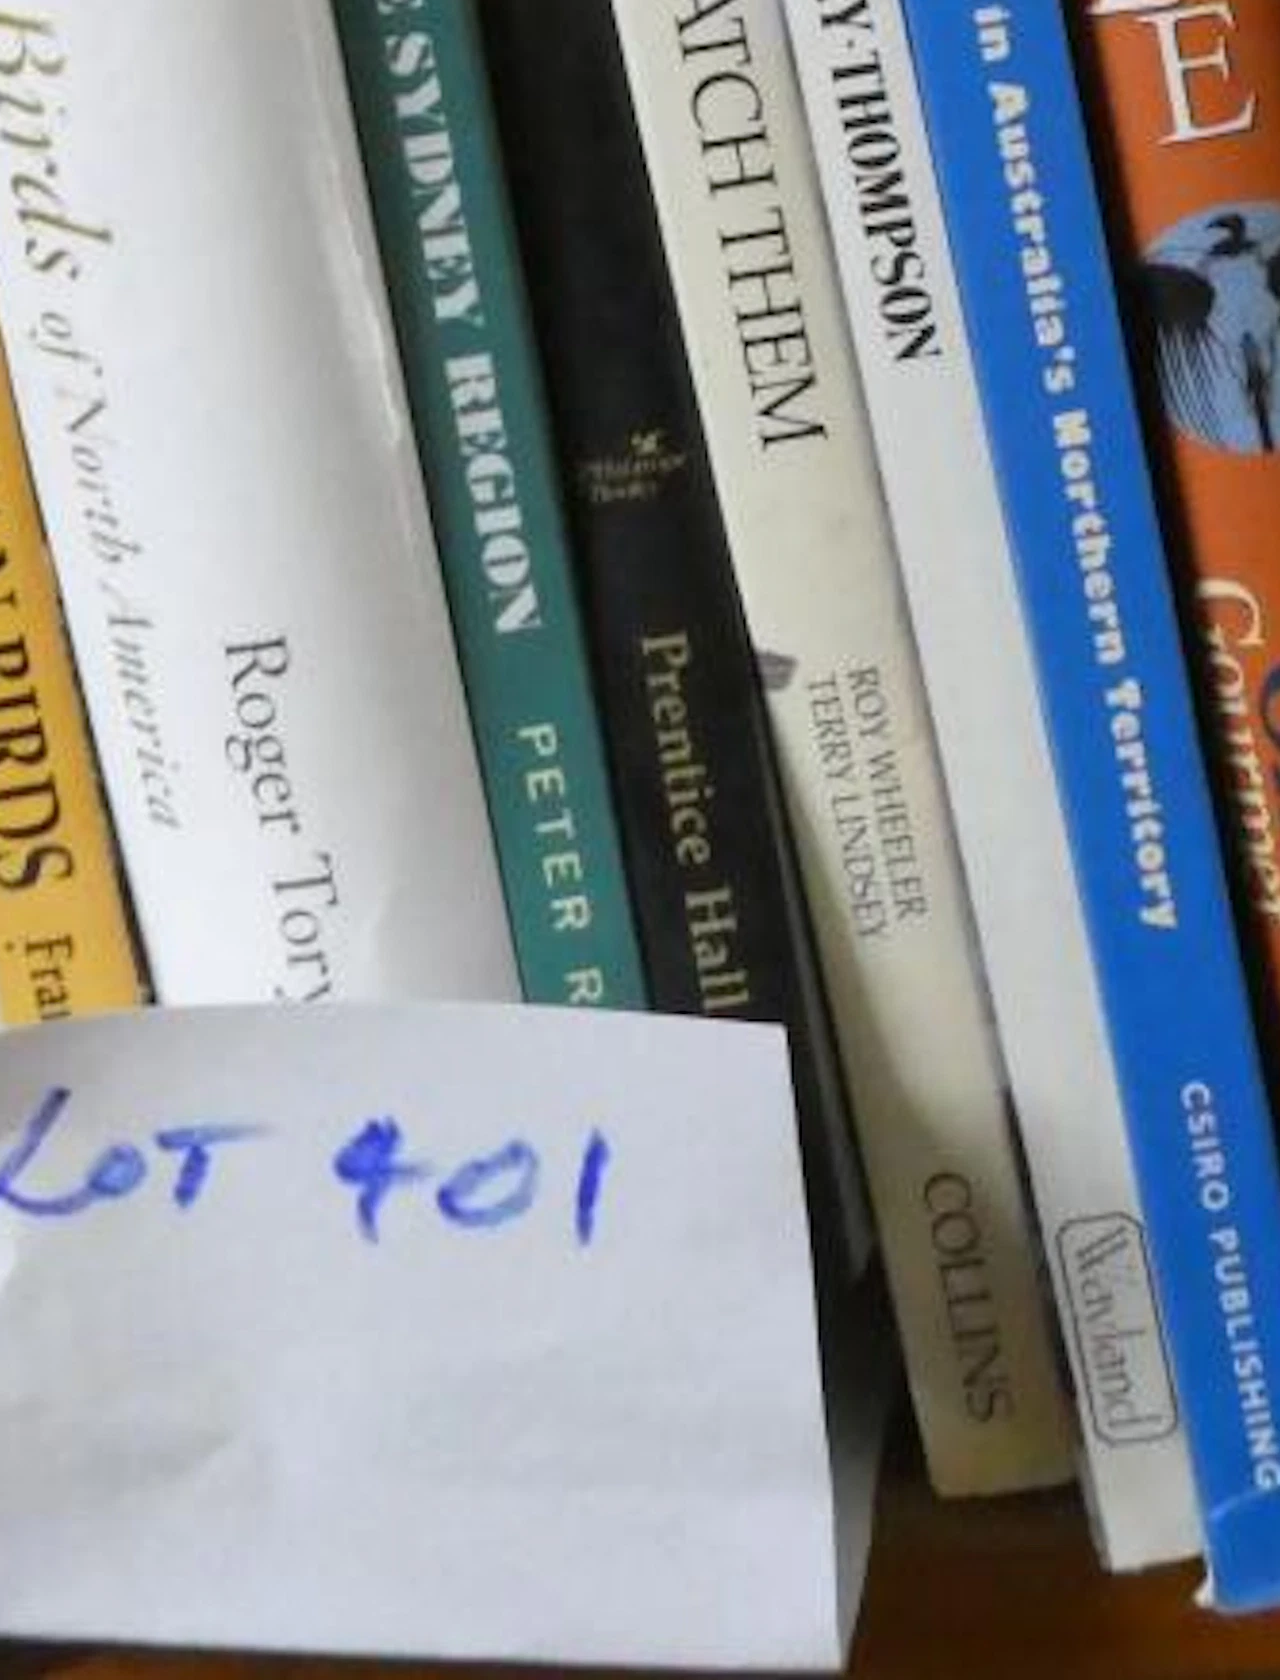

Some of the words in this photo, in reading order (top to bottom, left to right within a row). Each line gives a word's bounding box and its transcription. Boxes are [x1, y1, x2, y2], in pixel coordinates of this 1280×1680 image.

[972, 5, 1012, 62] in
[29, 310, 103, 377] of
[383, 31, 484, 328] SYDNEY
[445, 353, 542, 633] REGION
[721, 206, 829, 451] THEM
[989, 80, 1077, 396] Australia's
[55, 383, 142, 566] North
[1054, 408, 1127, 666] Northern
[98, 582, 181, 830] America
[224, 636, 302, 835] Roger
[808, 676, 856, 782] TERRY
[832, 786, 888, 938] LINDSEY
[846, 665, 890, 741] ROY
[1104, 678, 1179, 930] Territory
[518, 723, 593, 933] PETER
[642, 632, 715, 866] Prentice
[685, 887, 750, 1015] Hall
[867, 748, 927, 921] WHEELER
[332, 1114, 611, 1245] 401
[1180, 1079, 1230, 1212] CSIRO
[923, 1171, 1015, 1424] COLLINS
